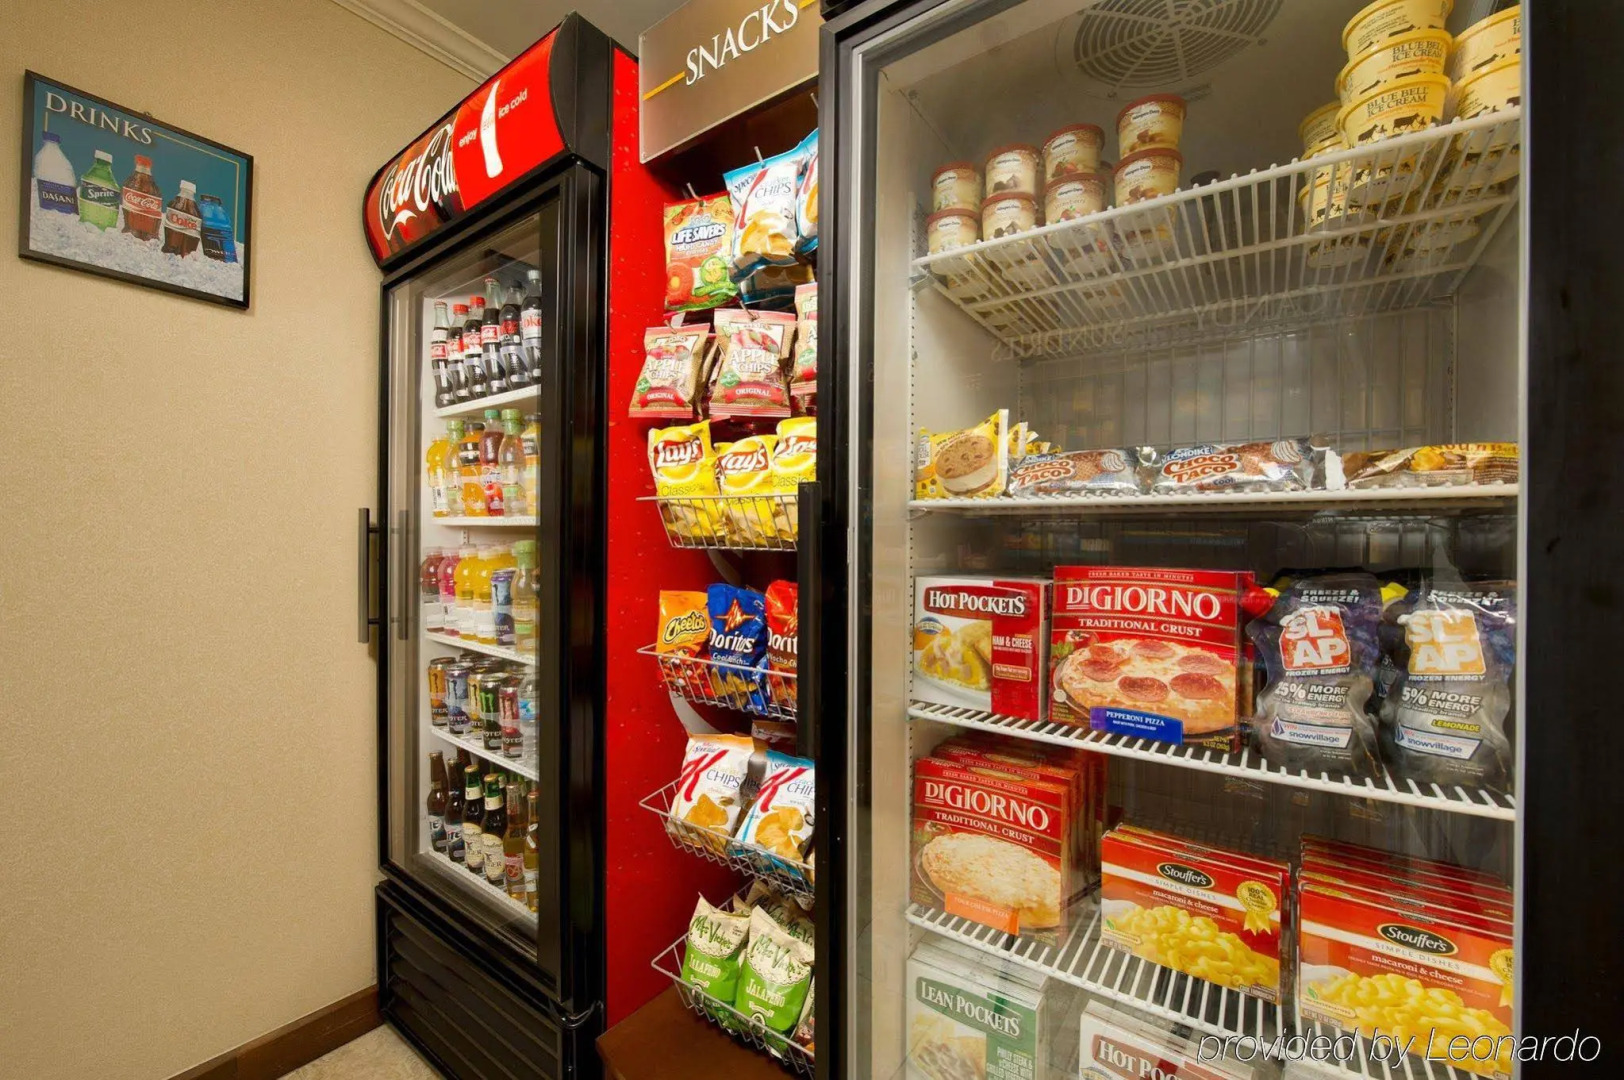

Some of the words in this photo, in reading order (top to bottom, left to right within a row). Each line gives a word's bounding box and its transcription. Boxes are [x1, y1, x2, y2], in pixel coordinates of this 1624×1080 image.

[686, 0, 798, 86] SNACKS
[1393, 41, 1424, 55] BLUE
[1393, 52, 1411, 63] ICE
[498, 102, 510, 119] ice
[510, 88, 528, 111] cold
[1367, 92, 1398, 110] BLUE
[1401, 86, 1429, 98] BELL
[1368, 105, 1385, 117] ICE
[1387, 95, 1427, 109] CREAM
[45, 91, 153, 145] DRINKS
[458, 127, 478, 148] enjoy
[42, 189, 76, 205] DASANI
[87, 187, 115, 200] Sprite
[755, 181, 792, 199] CHIPS
[124, 191, 161, 211] Coca-Cola
[170, 212, 198, 230] Coke
[645, 357, 687, 375] APPLE
[730, 348, 778, 366] APPLE
[649, 369, 678, 380] CHIPS
[737, 361, 772, 374] CHIPS
[646, 392, 675, 400] ORIGINAL
[735, 387, 771, 398] ORIGINAL
[656, 439, 701, 468] Lay's
[1011, 460, 1071, 478] CHOCO
[1163, 455, 1235, 476] CHOCO
[1172, 464, 1227, 483] TACO
[1018, 470, 1062, 487] TACO
[661, 484, 699, 497] Classic
[1163, 573, 1195, 582] MINUTES
[928, 590, 958, 610] HOT
[959, 592, 1026, 615] POCKETS
[663, 611, 707, 644] Cheetos
[1078, 617, 1159, 632] TRADITIONAL
[1161, 622, 1203, 637] CRUST
[710, 628, 756, 653] Doritos
[767, 627, 797, 653] Dorit
[1012, 637, 1032, 650] CHEESE
[1285, 669, 1319, 677] FROZEN
[1320, 667, 1351, 675] ENERGY
[1310, 684, 1349, 695] MORE
[1431, 691, 1482, 705] MORE
[1307, 692, 1347, 706] ENERGY
[1428, 699, 1481, 714] ENERGY
[1106, 710, 1144, 723] PEPPERONI
[1145, 718, 1166, 727] PIZZA
[1431, 719, 1480, 732] LEMONADE
[1289, 731, 1341, 743] snowvillage
[706, 768, 742, 790] CHIPS
[786, 782, 815, 796] CHIP
[935, 812, 1000, 833] TRADITIONAL
[1001, 828, 1035, 845] CRUST
[1163, 865, 1208, 886] Stouffer's
[1155, 879, 1185, 893] SIMPLE
[1186, 888, 1218, 901] DISHES
[1152, 889, 1186, 904] macaroni
[1187, 898, 1194, 906] &
[1194, 901, 1219, 913] cheese
[1387, 926, 1448, 953] Stouffer's
[1374, 942, 1415, 959] SIMPLE
[1419, 954, 1461, 971] DISHES
[1371, 954, 1419, 973] macaroni
[1420, 967, 1428, 976] &
[1429, 970, 1464, 985] cheese
[921, 981, 955, 1011] LEAN
[956, 995, 1020, 1037] POCKETS
[1098, 1038, 1137, 1073] HOT
